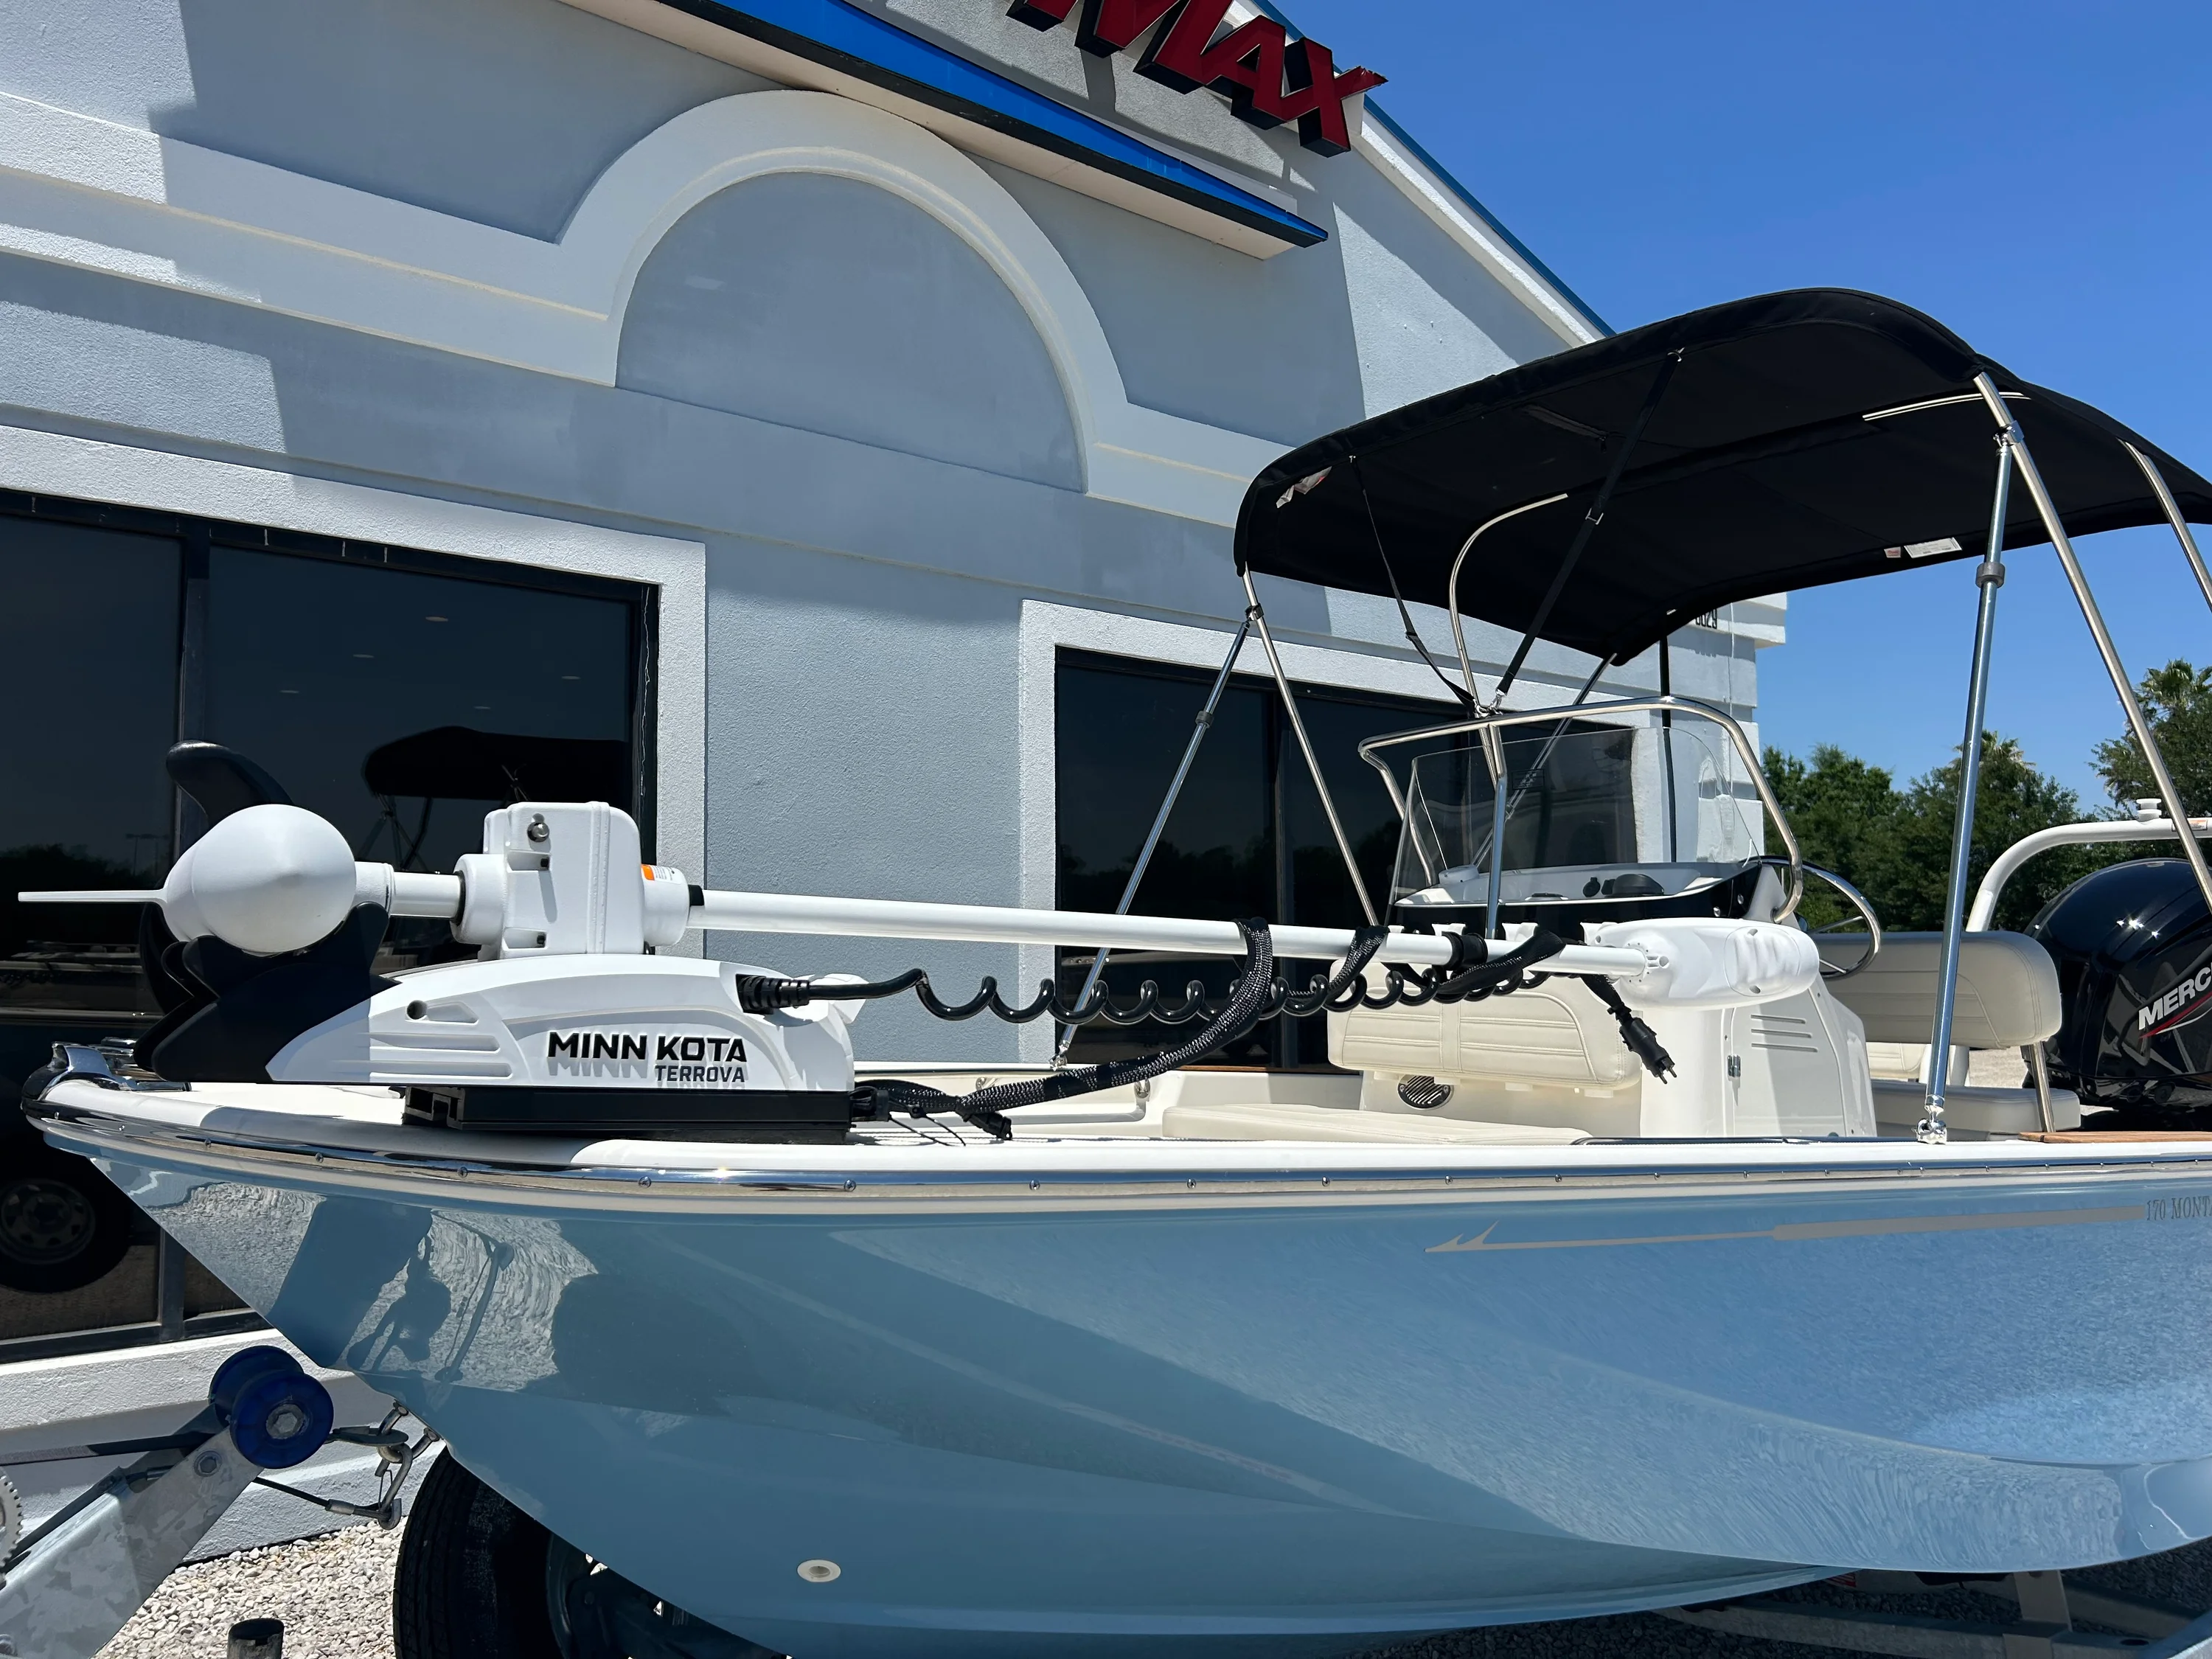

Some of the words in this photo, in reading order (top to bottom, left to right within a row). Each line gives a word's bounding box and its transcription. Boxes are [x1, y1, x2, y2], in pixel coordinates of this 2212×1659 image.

[2138, 961, 2212, 1031] MERC
[548, 1032, 647, 1060] MINN
[656, 1035, 747, 1062] KOTA
[655, 1065, 745, 1083] TERROVA
[2146, 1199, 2166, 1221] 170
[2171, 1194, 2212, 1220] MONT
